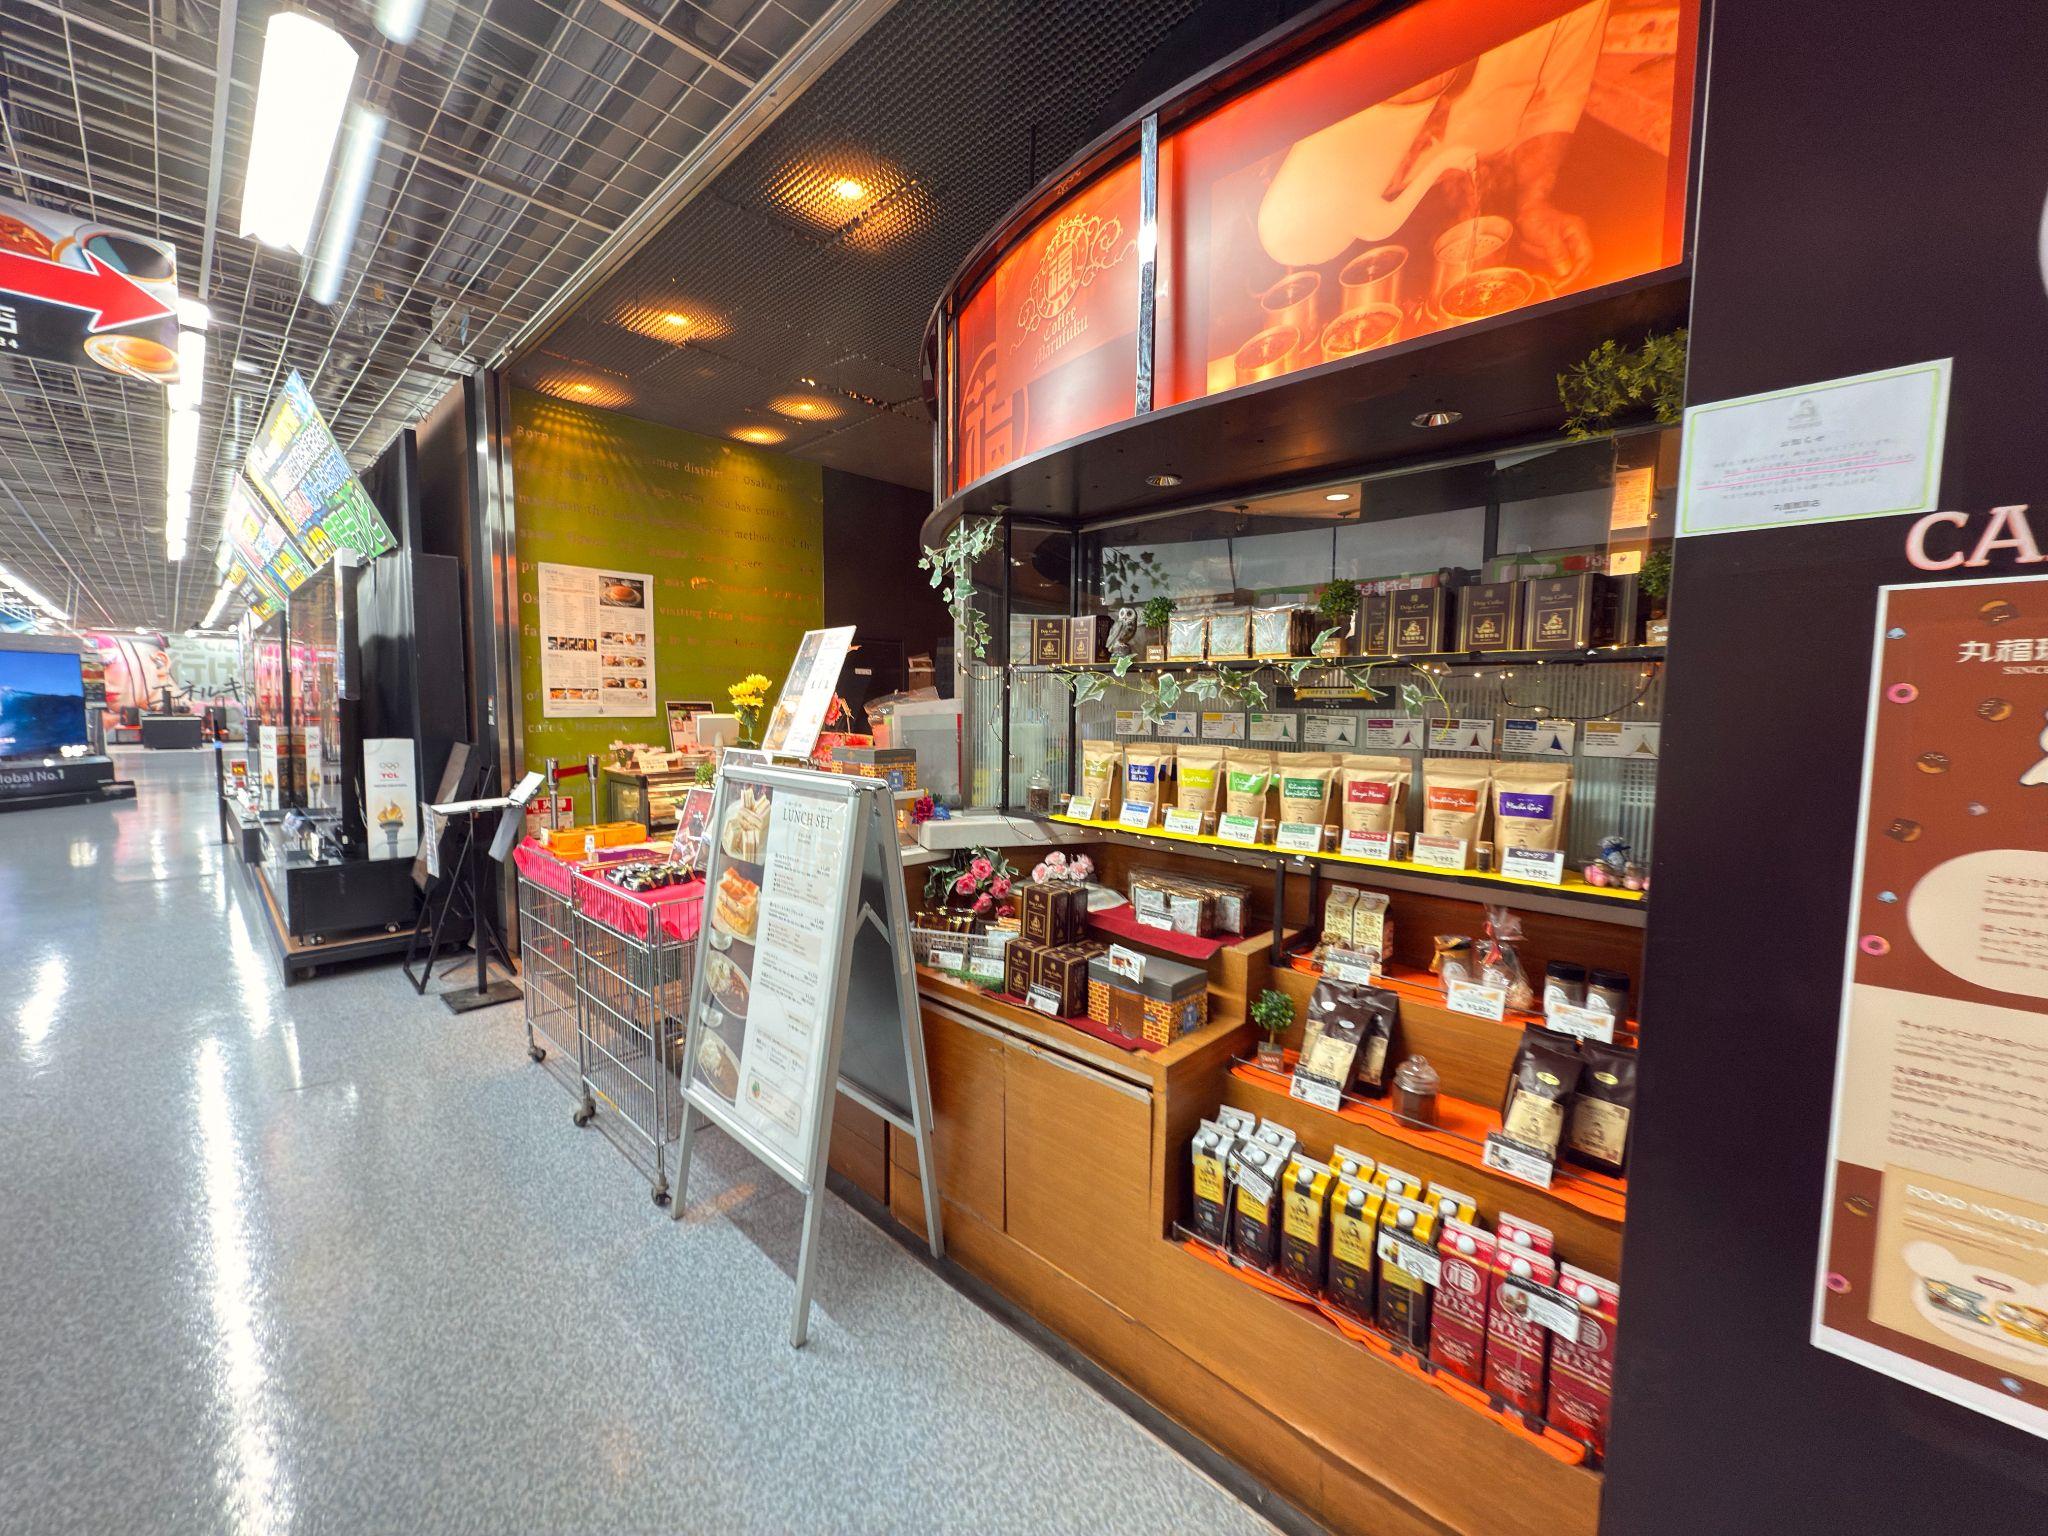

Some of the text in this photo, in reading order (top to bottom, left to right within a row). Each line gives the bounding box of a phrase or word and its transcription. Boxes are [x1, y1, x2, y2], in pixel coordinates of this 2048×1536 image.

[1048, 246, 1073, 300] 福
[1044, 306, 1077, 341] Coffee
[1906, 504, 2048, 571] CA
[36, 769, 65, 781] No.1
[380, 771, 399, 779] TCL
[783, 808, 832, 830] LUNCH SET
[1448, 1261, 1477, 1294] 福
